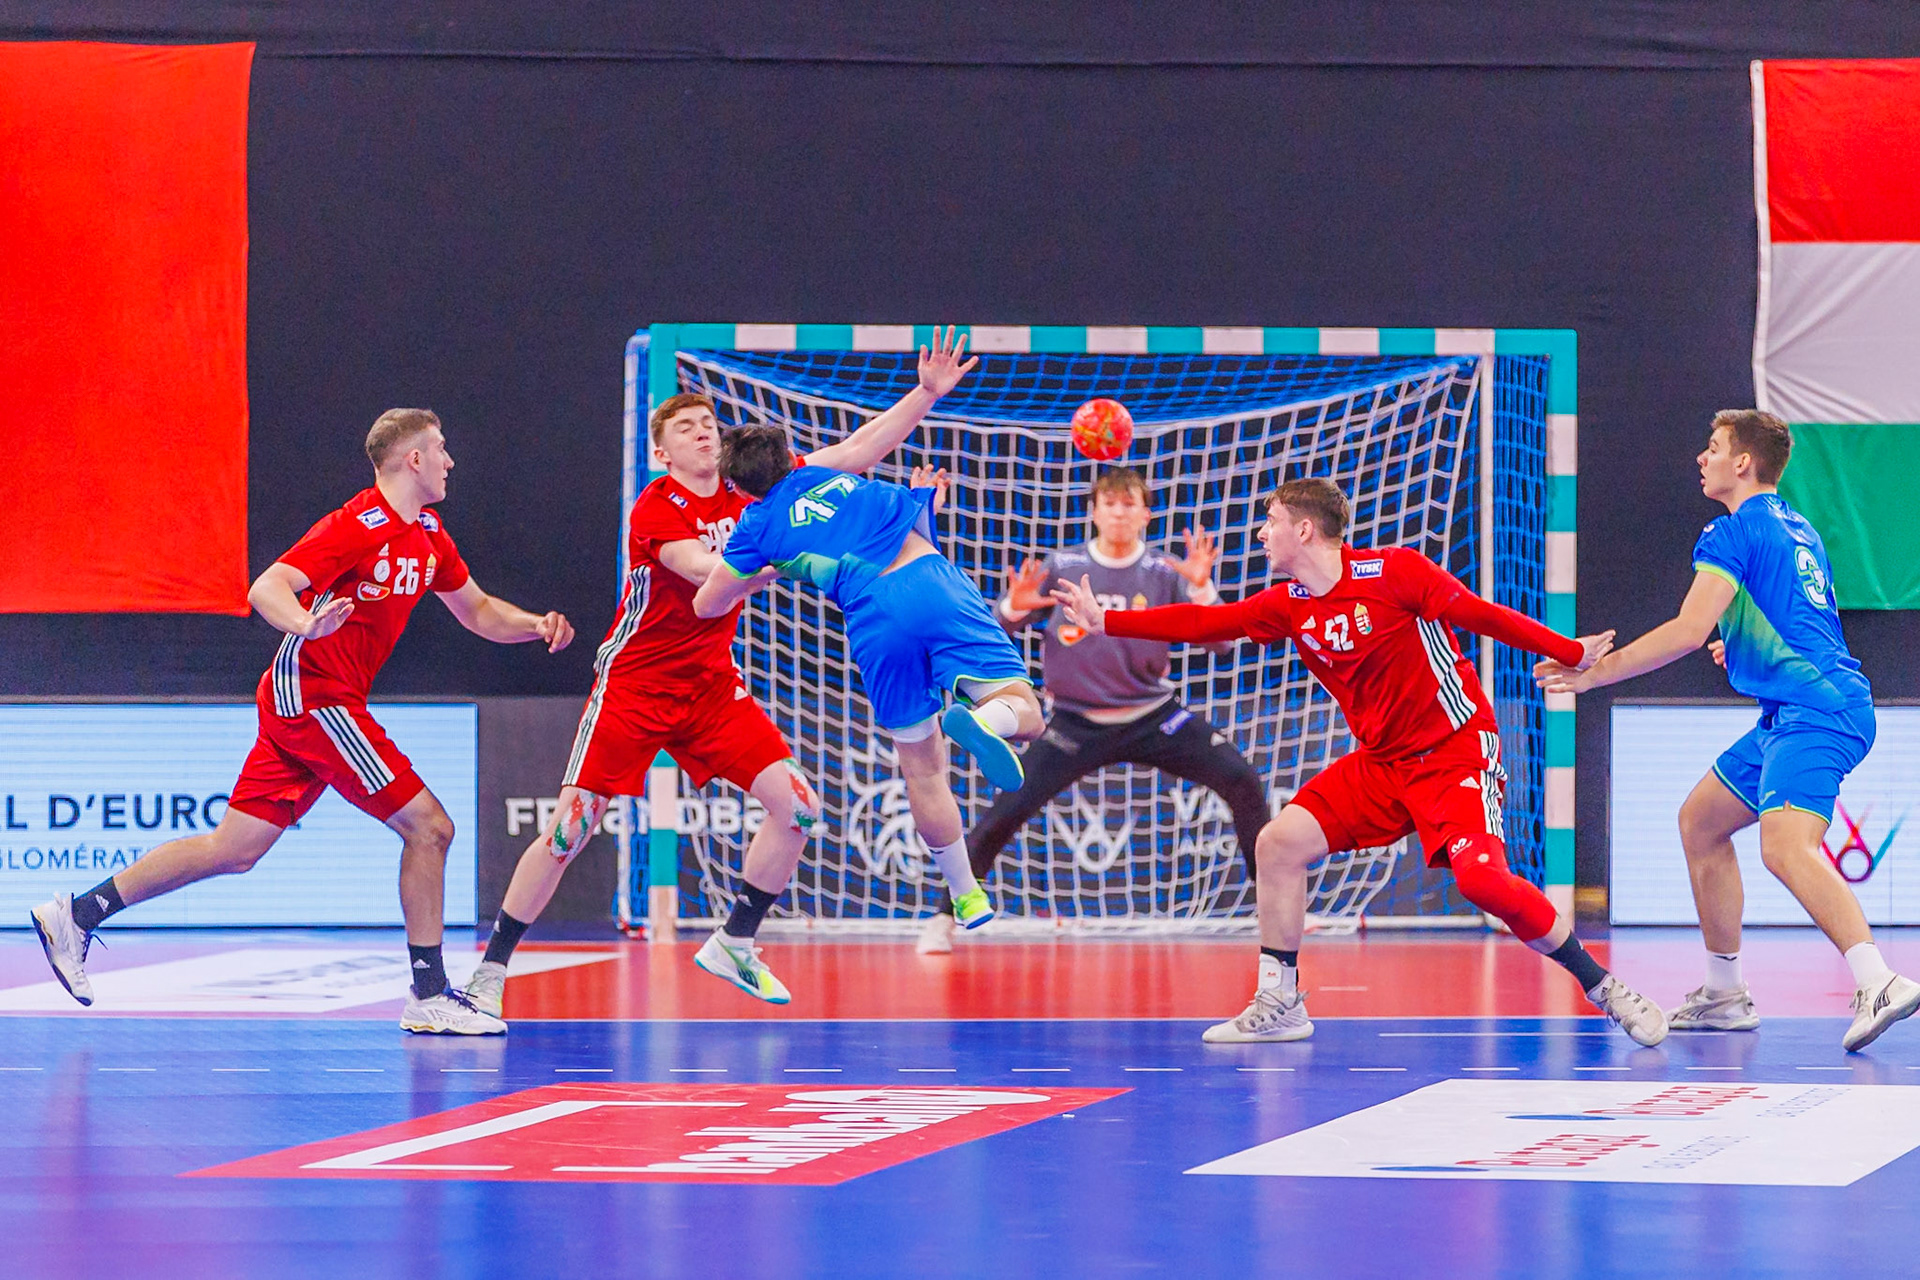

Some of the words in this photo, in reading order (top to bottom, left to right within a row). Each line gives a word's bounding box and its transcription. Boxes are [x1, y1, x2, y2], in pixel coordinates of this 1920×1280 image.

[789, 474, 858, 528] 17
[393, 557, 420, 595] 26
[1324, 613, 1354, 651] 52
[0, 795, 28, 830] L
[49, 793, 302, 830] D'EURO
[1170, 786, 1234, 823] VA
[0, 842, 148, 870] LOMÉRAT
[1582, 1086, 1769, 1115] Butagaz
[1455, 1134, 1660, 1167] Butagaz
